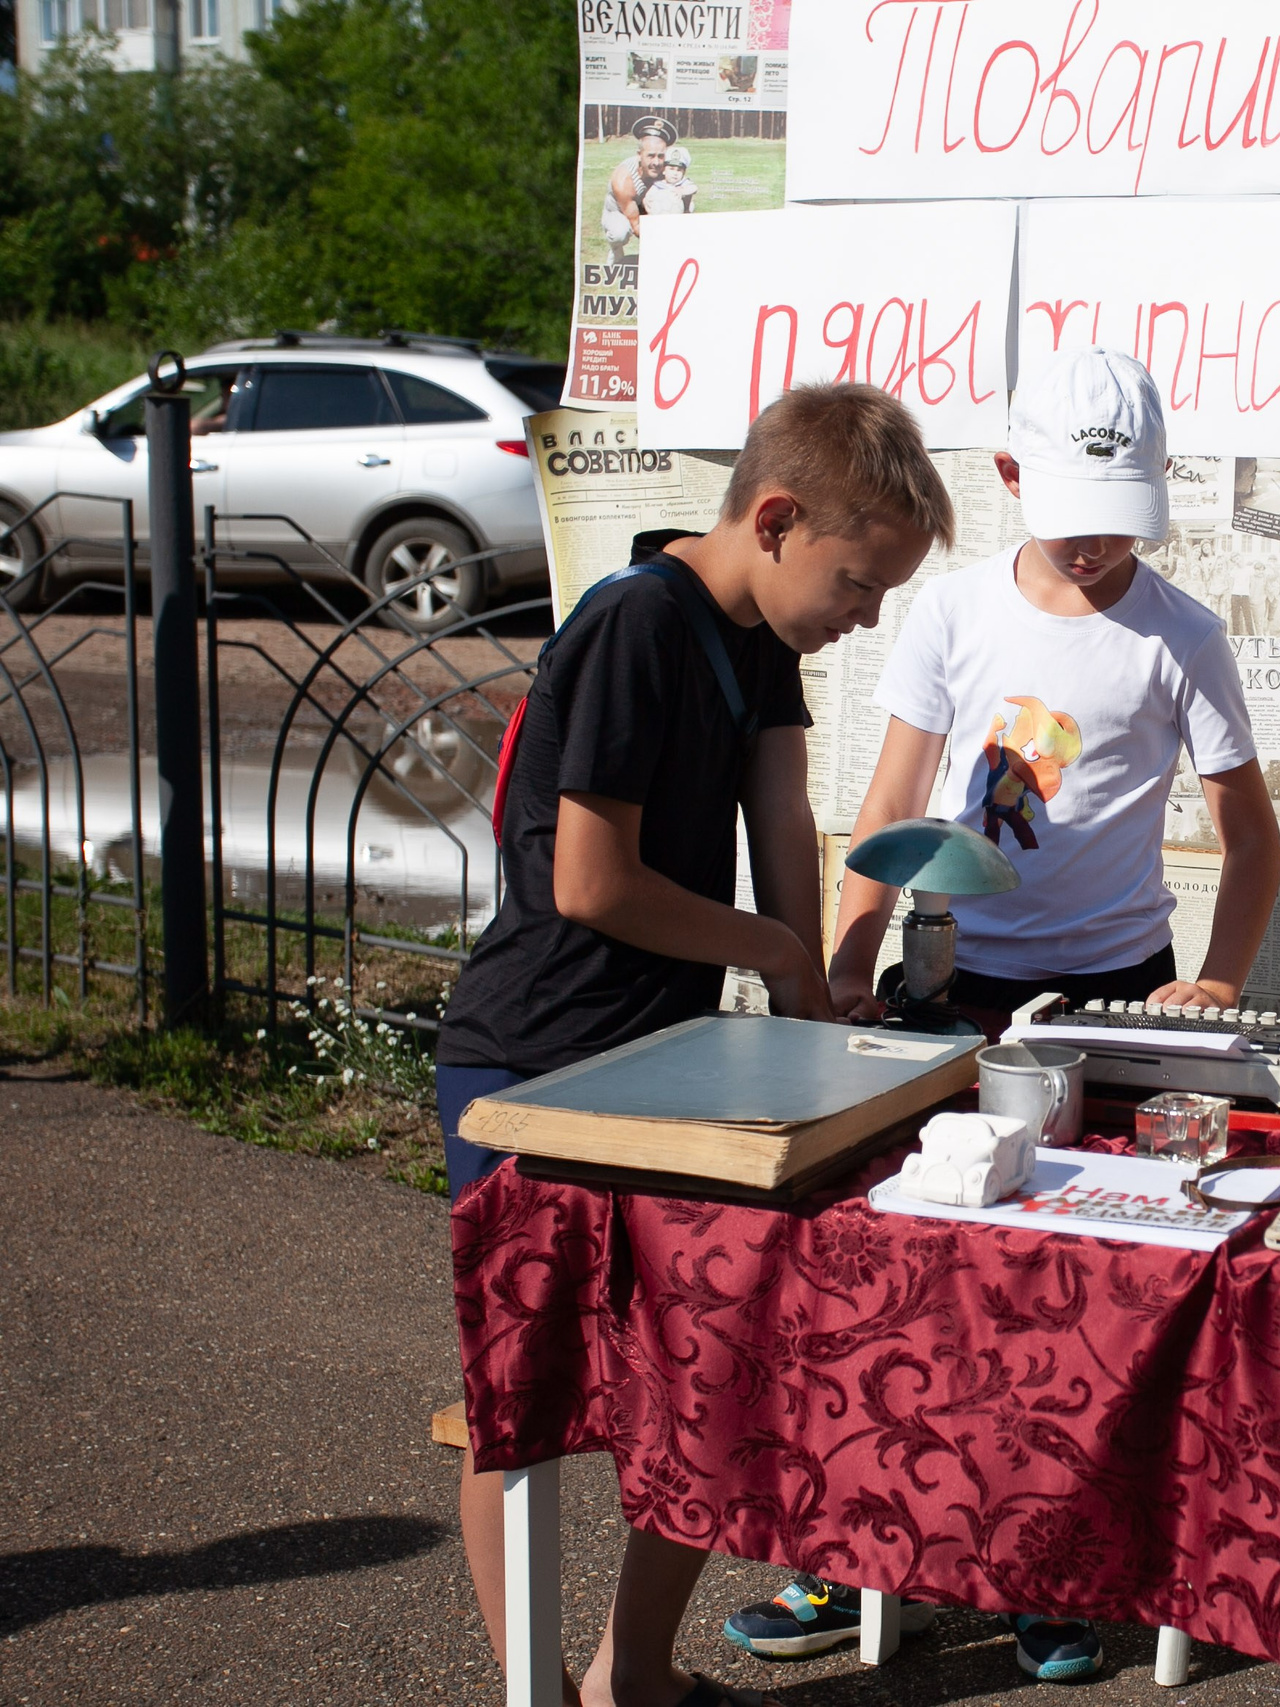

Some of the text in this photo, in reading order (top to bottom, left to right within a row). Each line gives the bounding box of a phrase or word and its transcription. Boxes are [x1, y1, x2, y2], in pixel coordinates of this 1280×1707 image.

[582, 0, 743, 43] ВЕДОМОСТИ
[641, 92, 655, 100] Стр.
[728, 95, 740, 104] Стр.
[602, 331, 621, 339] БАНК
[649, 257, 699, 410] в
[582, 349, 614, 357] ХОРОШИЙ
[579, 374, 635, 399] 11,9%
[542, 430, 637, 450] ВЛАС
[1071, 426, 1134, 448] LACOSTE
[547, 449, 673, 477] СОВЕТОВ
[1166, 461, 1206, 484] ки
[554, 512, 637, 524] В авангарде коллектива
[660, 508, 699, 519] Отличник
[1060, 1184, 1170, 1206] Нам
